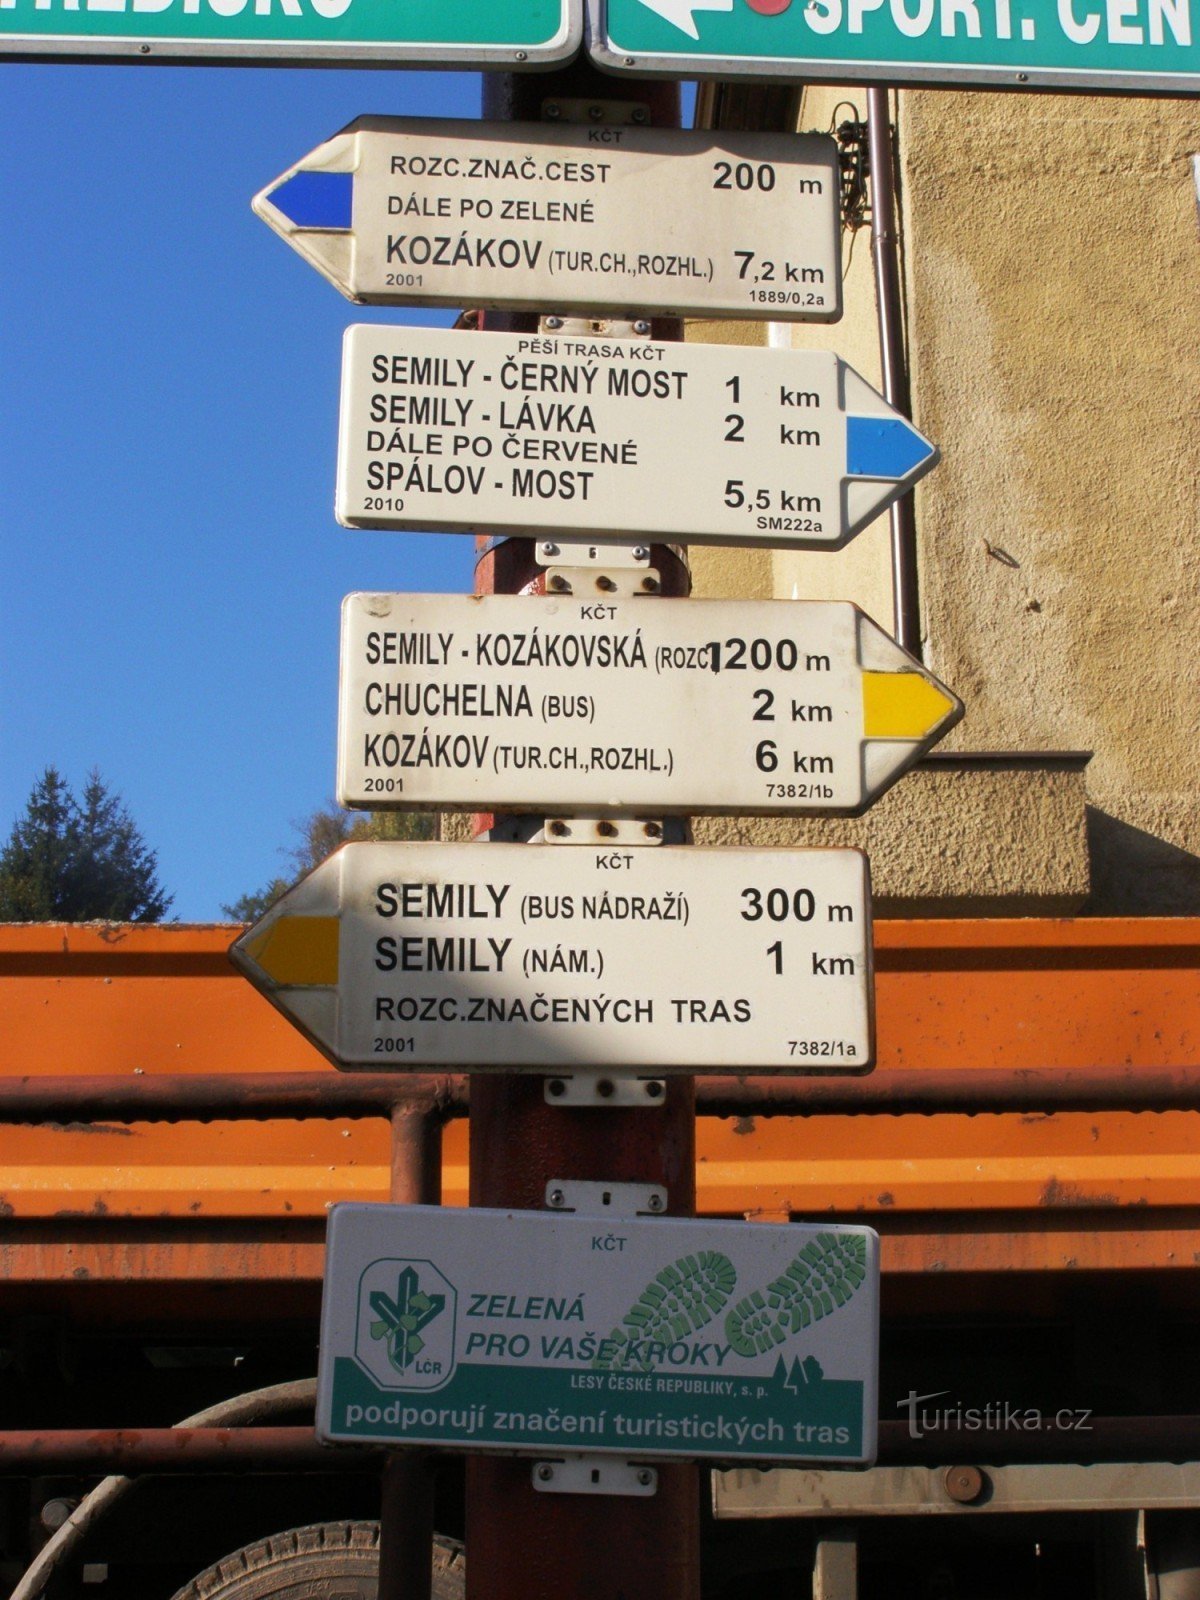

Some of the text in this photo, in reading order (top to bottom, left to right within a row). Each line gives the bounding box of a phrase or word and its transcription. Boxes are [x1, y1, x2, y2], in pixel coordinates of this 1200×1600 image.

[586, 125, 625, 143] KČT
[390, 155, 823, 195] ROZC.ZNAČ.CEST 200 m
[387, 191, 594, 223] DÁLE PO ZELENÉ
[386, 230, 543, 269] KOZÁKOV
[734, 250, 775, 284] 7,2
[785, 262, 824, 284] km
[385, 273, 423, 287] 2001
[749, 289, 825, 307] 1889/0,2a
[518, 338, 666, 361] PĚŠÍ TRASA KČT
[371, 354, 475, 388] SEMILY
[500, 355, 599, 395] ČERNÝ
[608, 367, 688, 400] MOST
[725, 375, 740, 404] 1
[780, 385, 820, 408] km
[369, 393, 474, 429] SEMILY
[499, 395, 596, 436] LÁVKA
[724, 413, 745, 443] 2
[780, 424, 821, 446] km
[367, 426, 638, 465] DÁLE PO ČERVENÉ
[366, 455, 486, 495] SPÁLOV
[512, 468, 594, 501] MOST
[724, 479, 771, 513] 5,5
[780, 490, 821, 513] km
[363, 496, 404, 512] 2010
[756, 516, 823, 533] SM222a
[580, 603, 618, 620] KČT
[365, 631, 454, 665] SEMILY
[476, 626, 648, 668] KOZÁKOVSKÁ
[704, 637, 798, 675] 1200
[806, 655, 831, 672] m
[365, 682, 833, 724] CHUCHELNA (BUS) 2 km
[364, 726, 490, 769] KOZÁKOV
[755, 739, 779, 773] 6
[793, 751, 834, 774] km
[364, 778, 404, 793] 2001
[766, 783, 834, 799] 7382/1b
[596, 853, 634, 870] KČT
[373, 882, 853, 927] SEMILY (BUS NÁDRAŽÍ) 300 m
[372, 934, 855, 980] SEMILY (NÁM.) 1 km
[373, 991, 752, 1026] ROZC.ZNAČENÝCH TRAS
[373, 1037, 414, 1053] 2001
[788, 1041, 857, 1056] 7382/1a
[591, 1233, 628, 1252] KČT
[466, 1293, 586, 1321] ZELENÁ
[465, 1332, 733, 1367] PRO VAŠE KROKY
[570, 1374, 605, 1389] LESY
[608, 1370, 654, 1392] ČESKÉ
[656, 1378, 737, 1398] REPUBLIKY,
[346, 1400, 850, 1444] podporují značení turistických tras
